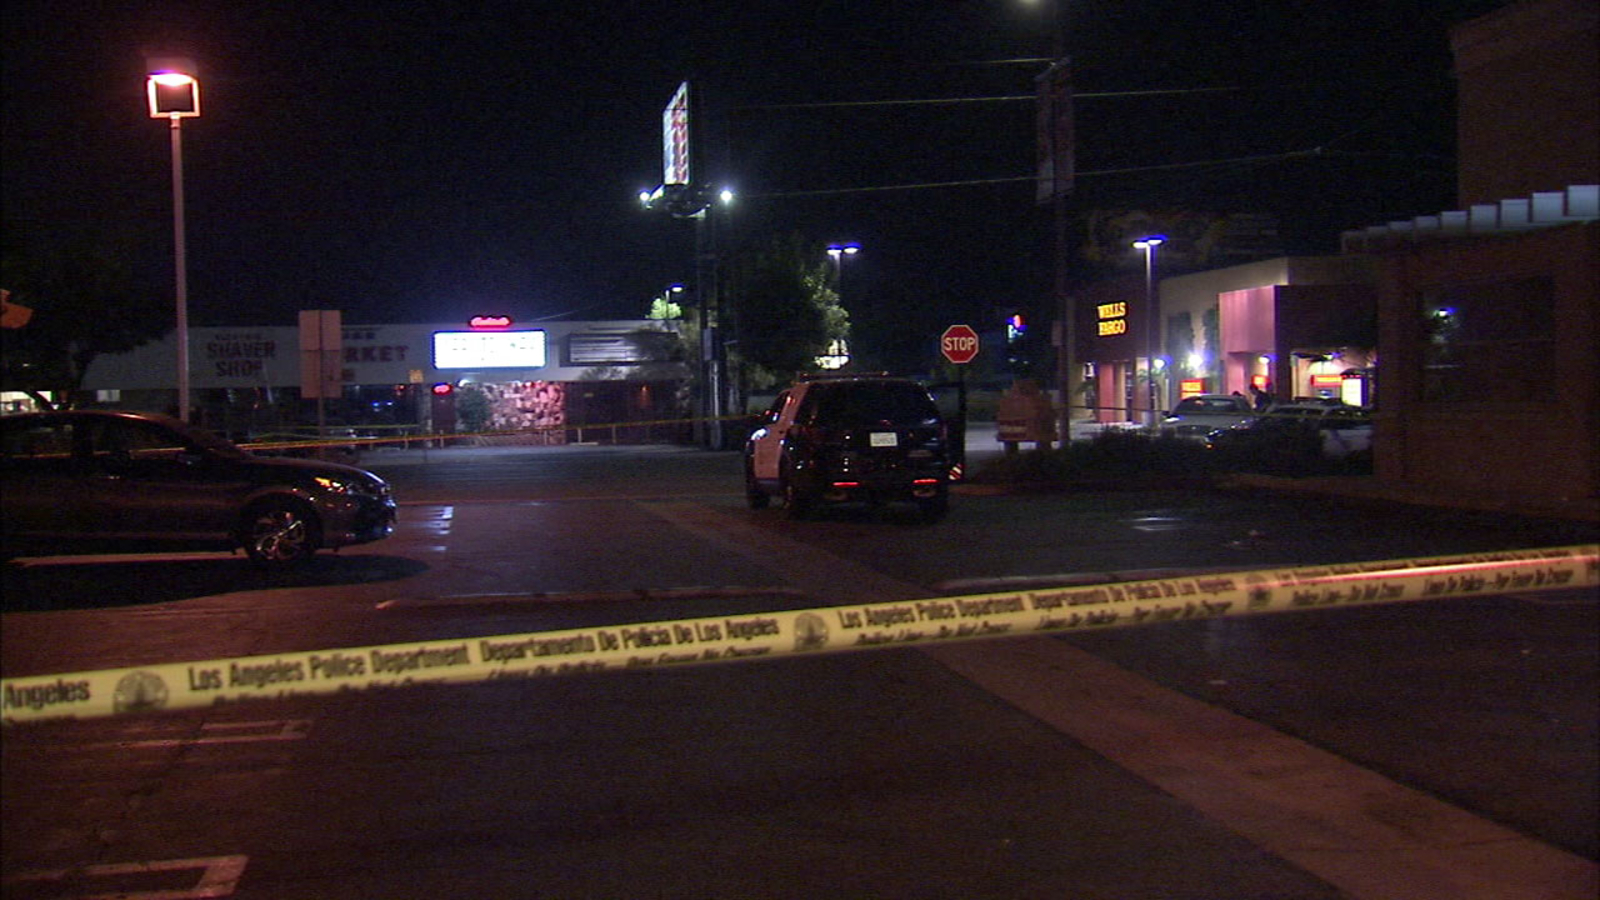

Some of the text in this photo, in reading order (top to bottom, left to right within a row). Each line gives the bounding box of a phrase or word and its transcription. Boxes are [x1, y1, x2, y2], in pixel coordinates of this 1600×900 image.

[1097, 301, 1126, 319] WELLS
[1098, 319, 1126, 336] FARGO
[207, 340, 276, 358] SHAVER
[944, 336, 976, 351] STOP
[216, 360, 263, 377] SHOP
[3, 679, 91, 710] Angeles
[188, 666, 222, 691] Los
[229, 658, 305, 688] Angeles
[309, 652, 366, 679] Police
[370, 643, 470, 674] Department
[479, 633, 597, 665] Departamento
[598, 630, 619, 651] De
[672, 623, 693, 645] De
[695, 621, 723, 642] Los
[725, 616, 780, 641] Angeles
[838, 609, 863, 629] Los
[864, 604, 917, 628] Angeles
[915, 600, 957, 622] Police
[955, 594, 1025, 618] Department
[1028, 587, 1110, 612] Departamento
